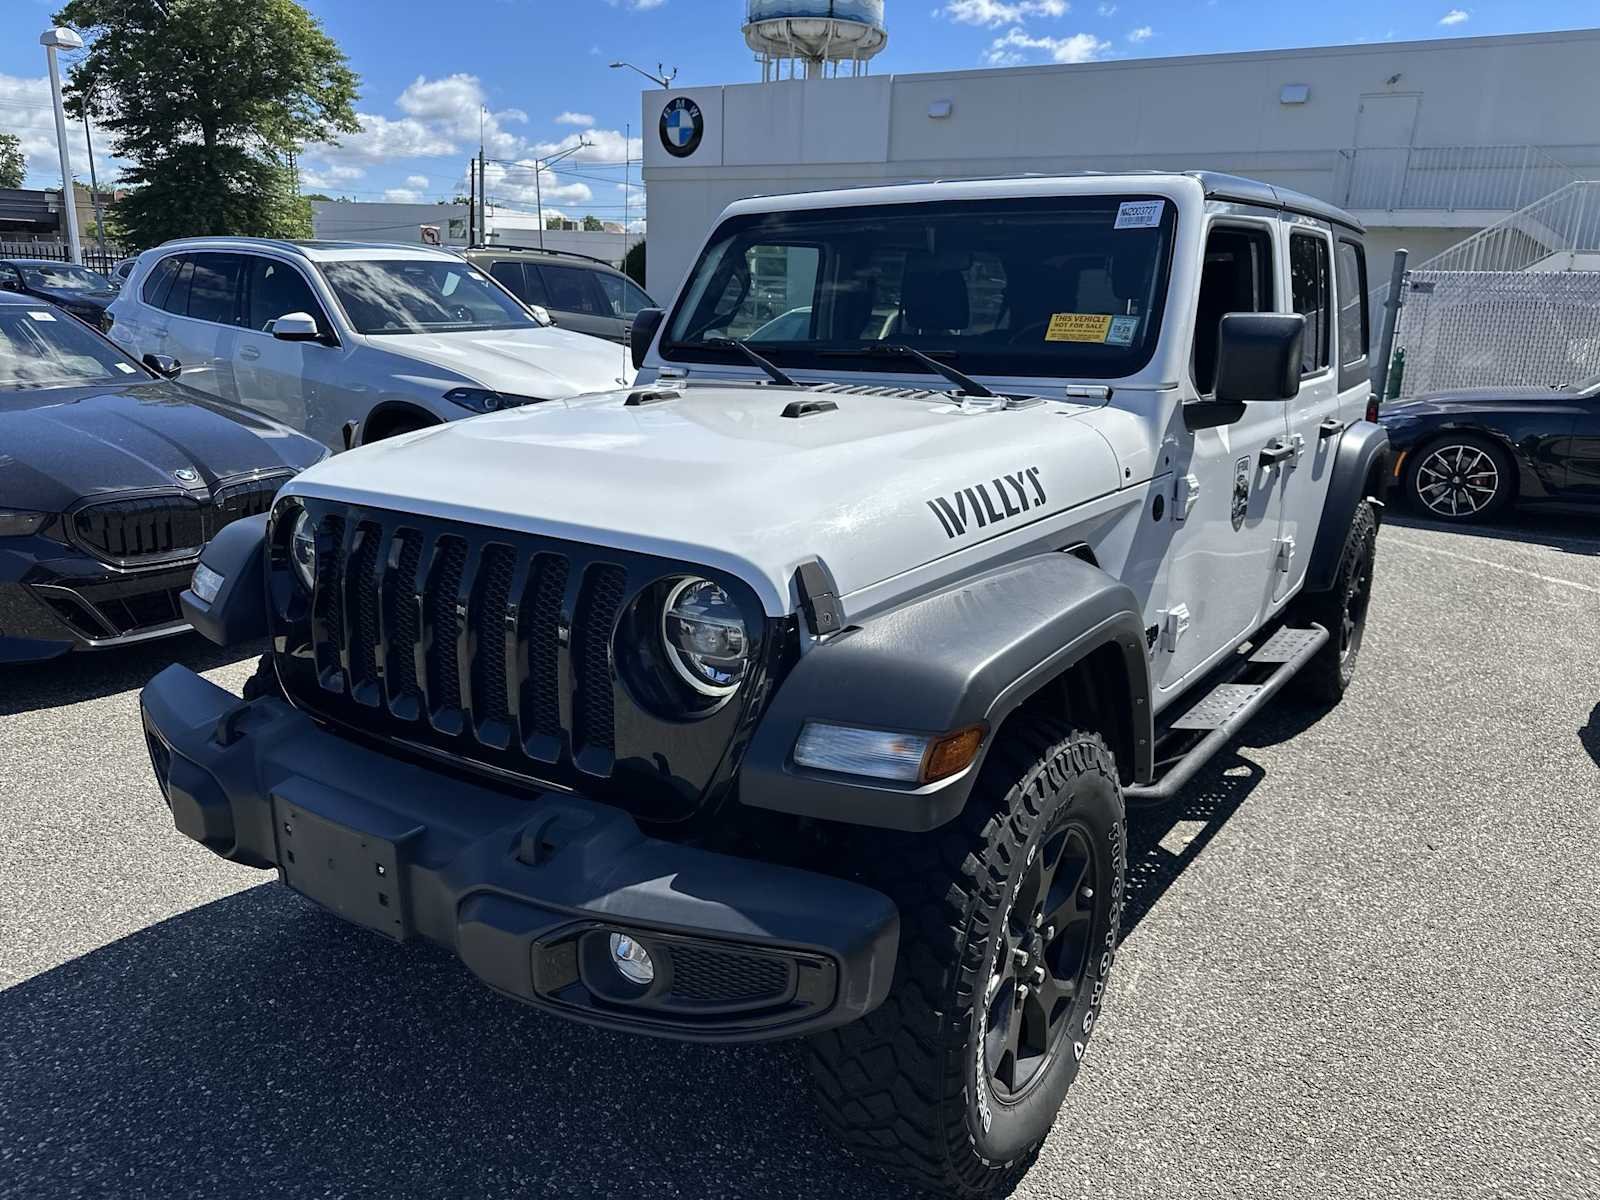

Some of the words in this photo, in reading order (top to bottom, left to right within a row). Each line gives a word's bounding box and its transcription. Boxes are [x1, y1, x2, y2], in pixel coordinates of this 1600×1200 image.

[663, 99, 700, 119] BMW
[1074, 315, 1107, 323] VEHICLE
[926, 466, 1047, 539] WILLYS
